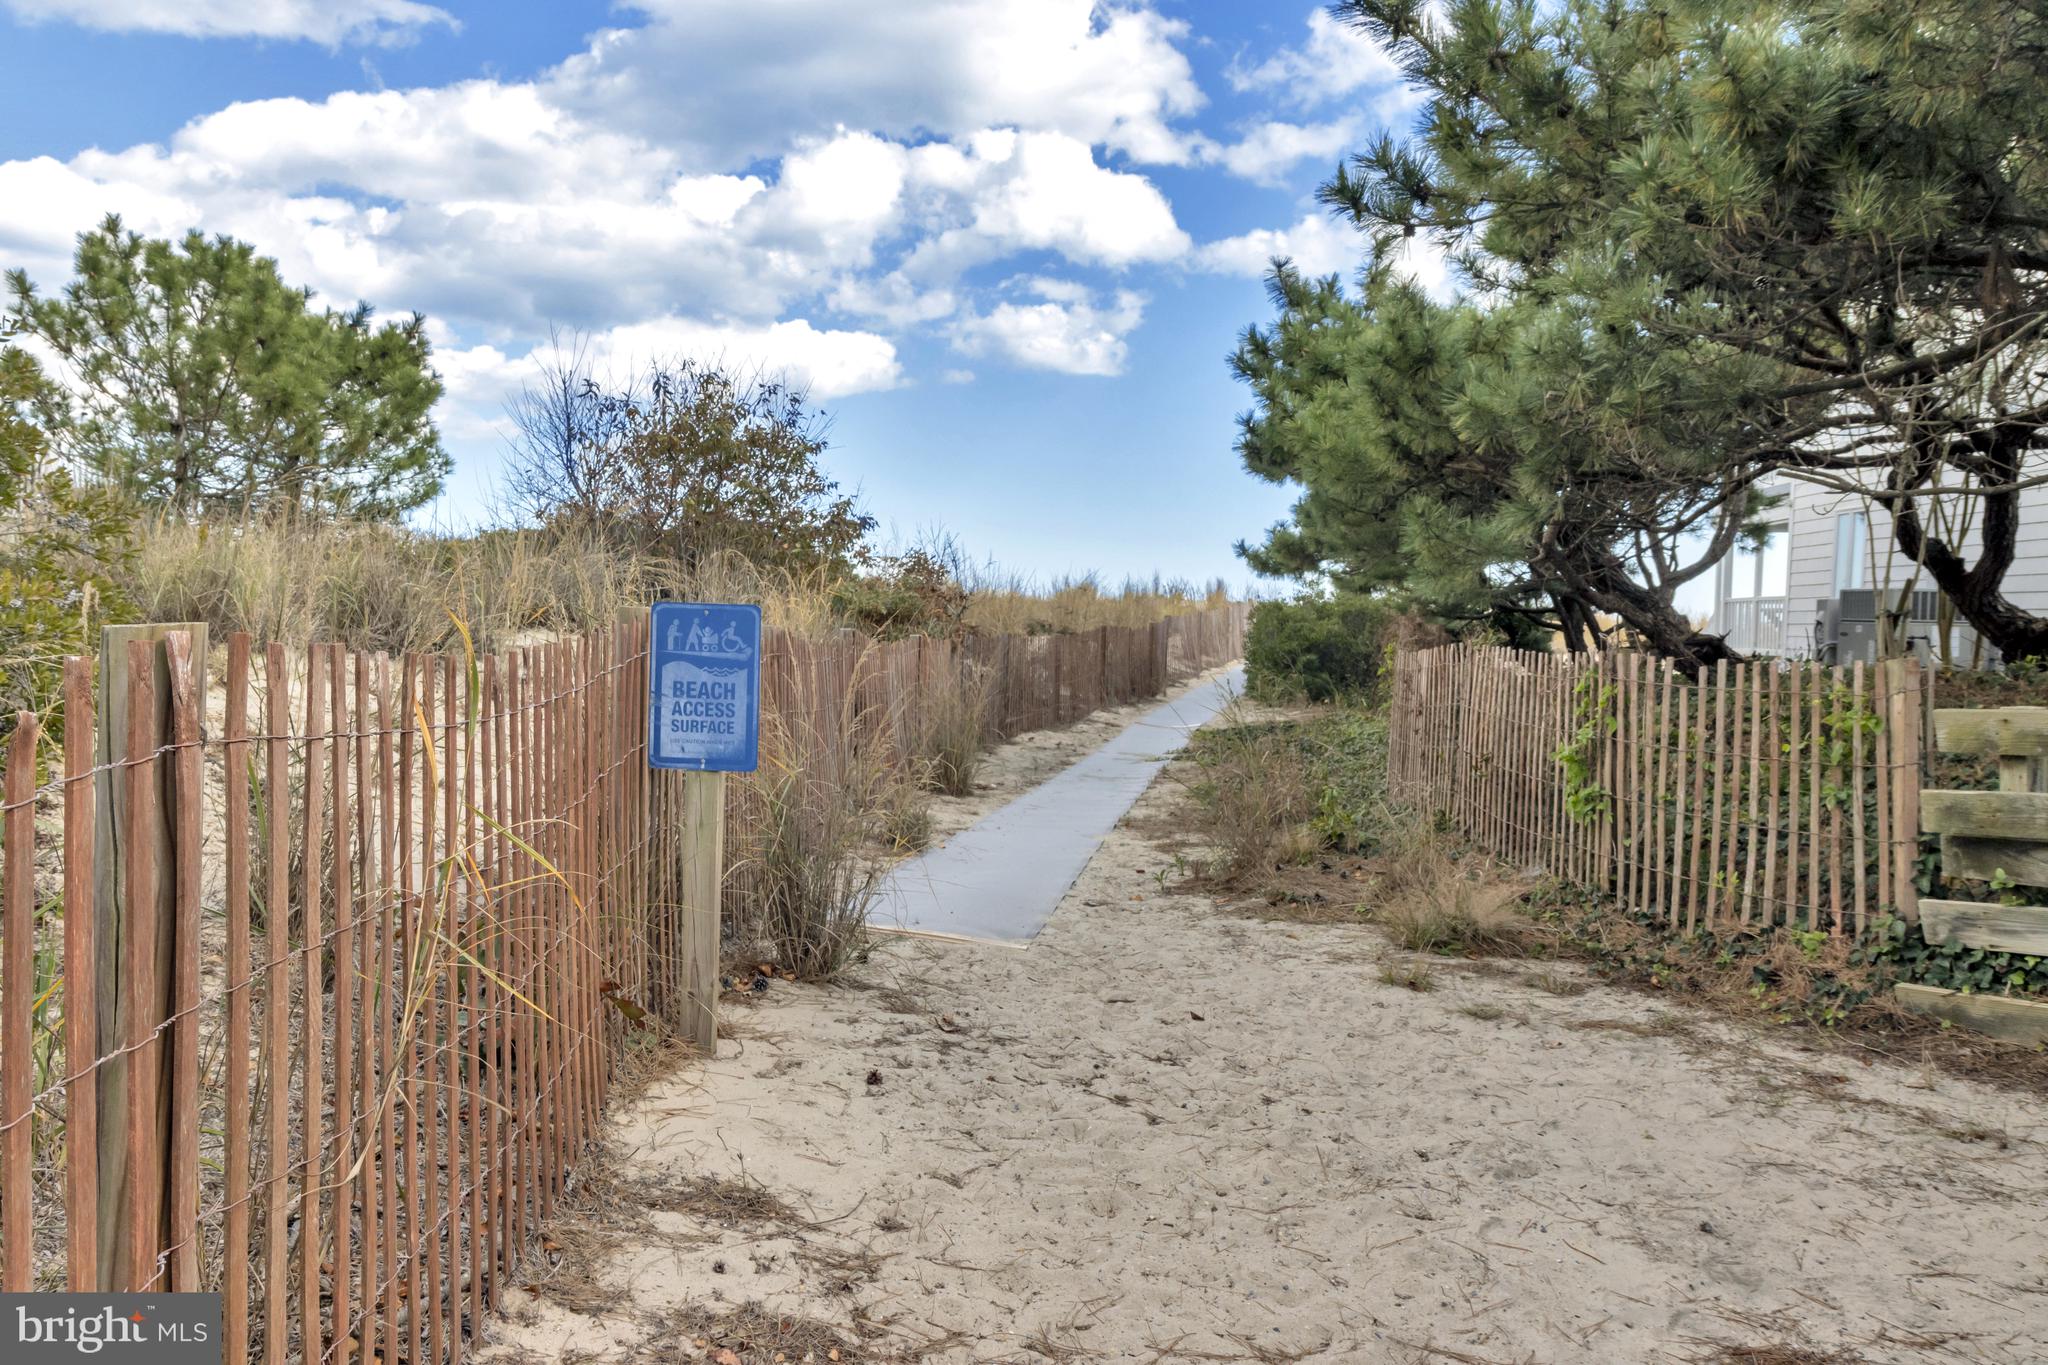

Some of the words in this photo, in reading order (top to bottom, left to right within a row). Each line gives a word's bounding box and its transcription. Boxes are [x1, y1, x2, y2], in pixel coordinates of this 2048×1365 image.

[673, 680, 736, 700] BEACH
[671, 701, 736, 718] ACCESS
[671, 719, 735, 735] SURFACE
